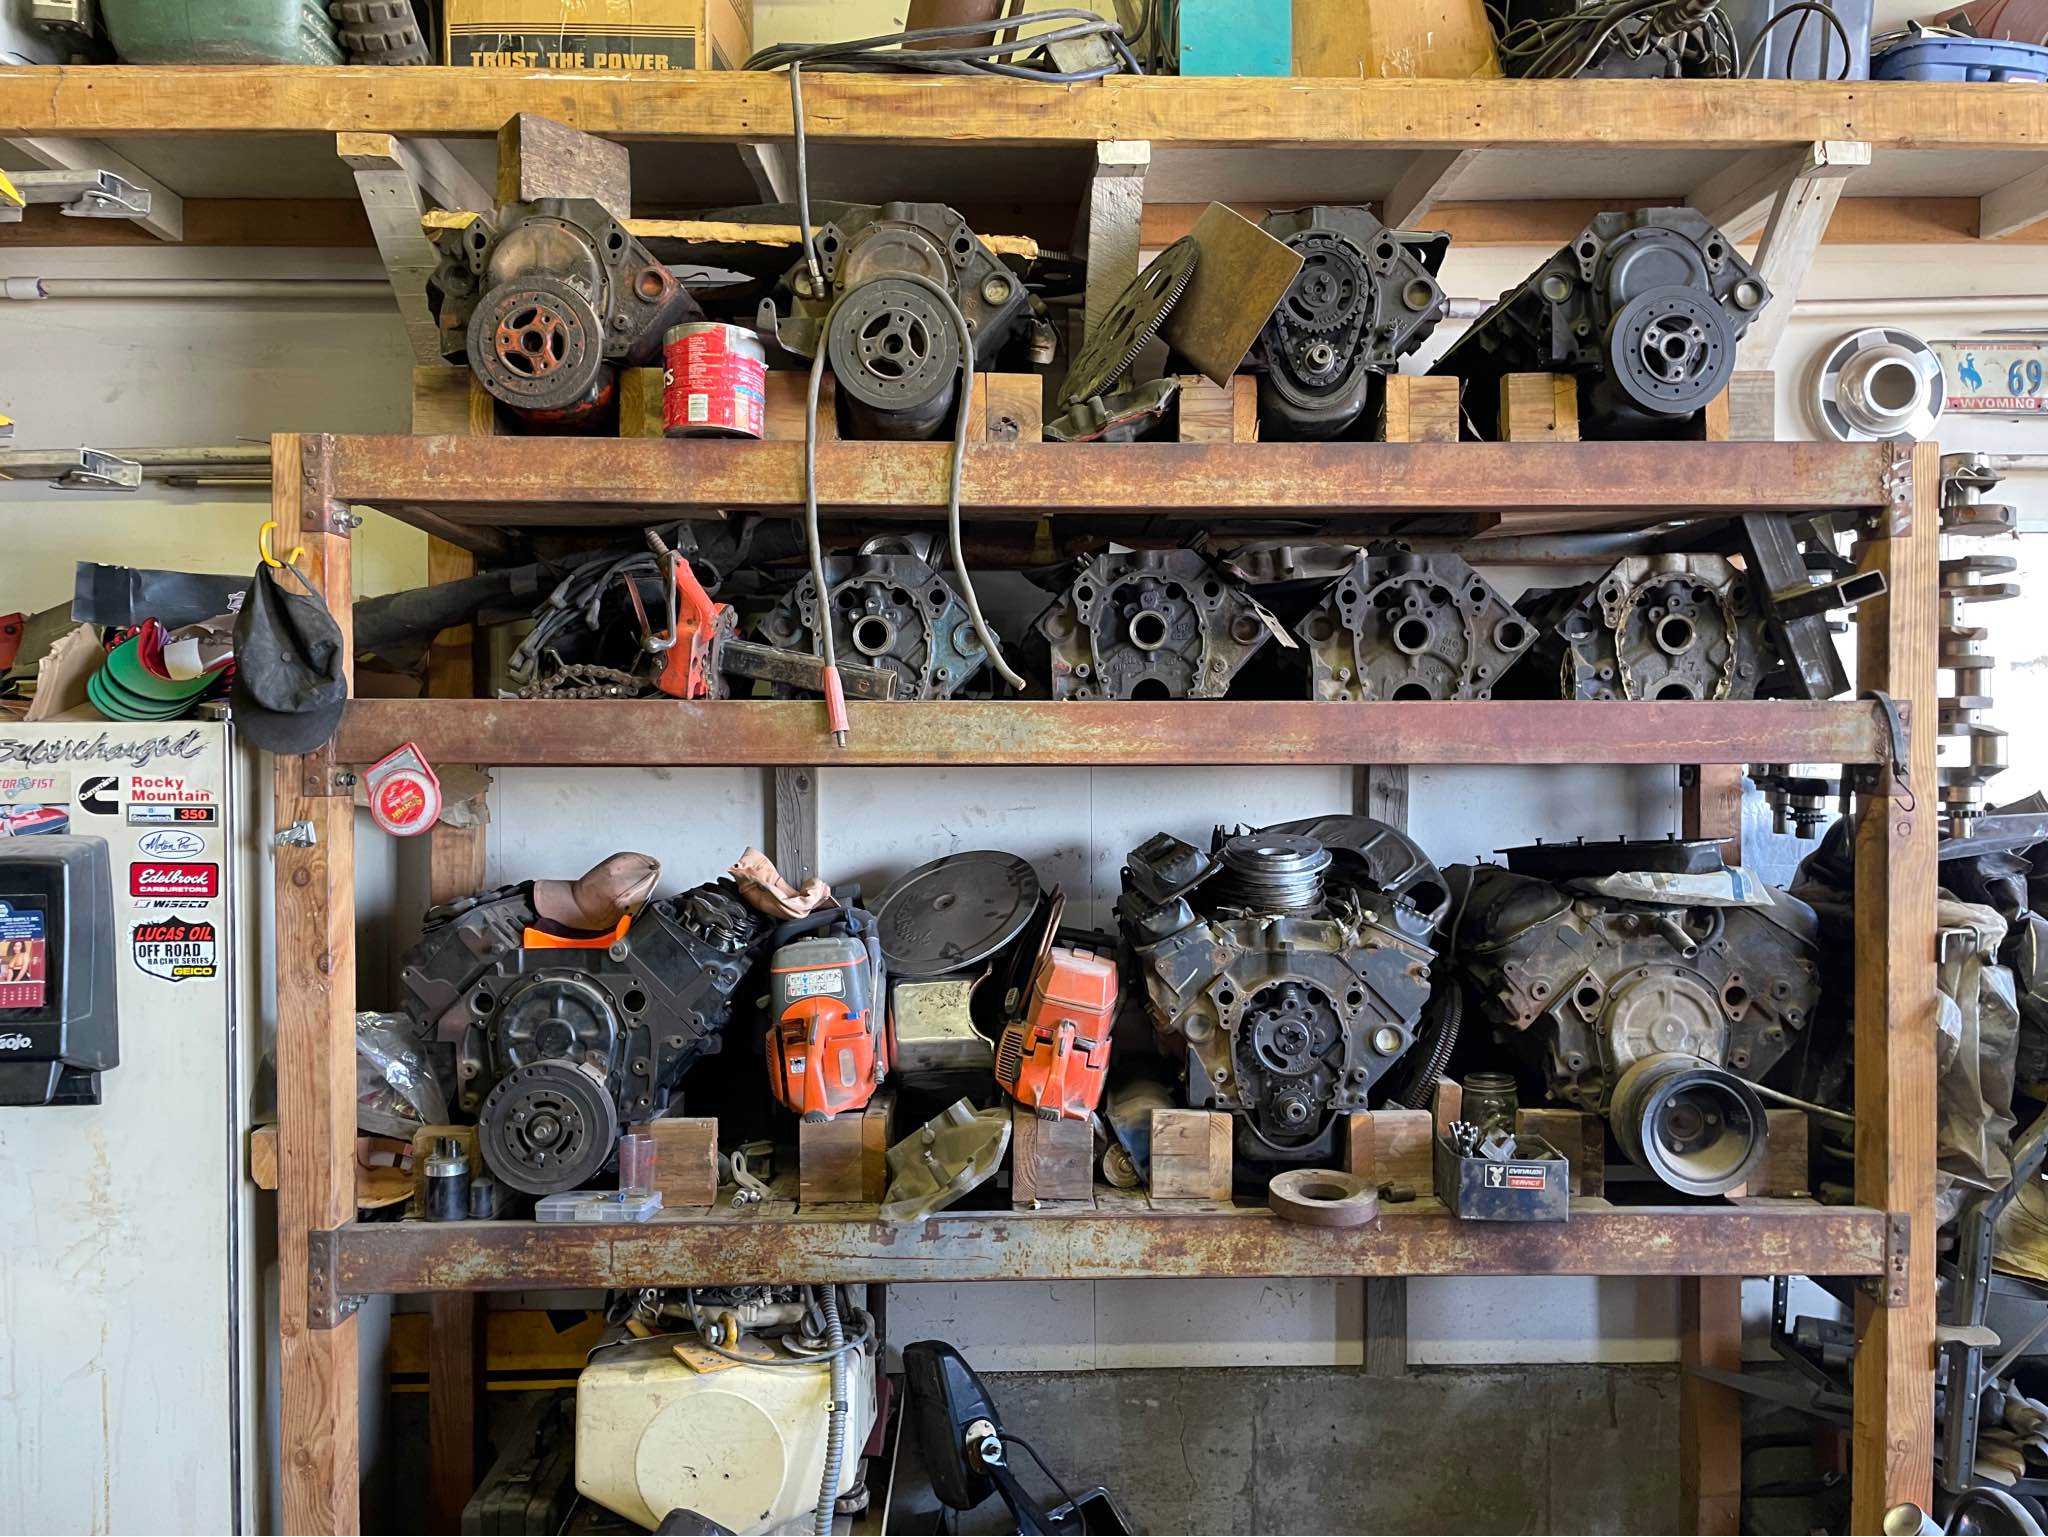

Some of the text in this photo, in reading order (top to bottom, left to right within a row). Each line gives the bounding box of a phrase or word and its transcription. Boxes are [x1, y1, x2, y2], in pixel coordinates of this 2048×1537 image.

[470, 52, 669, 70] TRUST THE POWER
[2008, 359, 2042, 396] 69
[1960, 398, 2035, 409] WYOMING
[32, 778, 56, 789] FIST
[78, 776, 116, 801] Cummins
[131, 776, 184, 790] Rocky
[131, 789, 211, 802] Mountain
[180, 809, 208, 820] 350
[177, 836, 200, 850] Pro
[138, 868, 209, 885] Edelbrock
[135, 926, 213, 941] LUCAS OIL
[138, 943, 201, 958] OFF ROAD
[147, 957, 210, 965] RACING SERIES
[173, 967, 213, 976] GEICO
[1511, 1179, 1541, 1187] SERVICE
